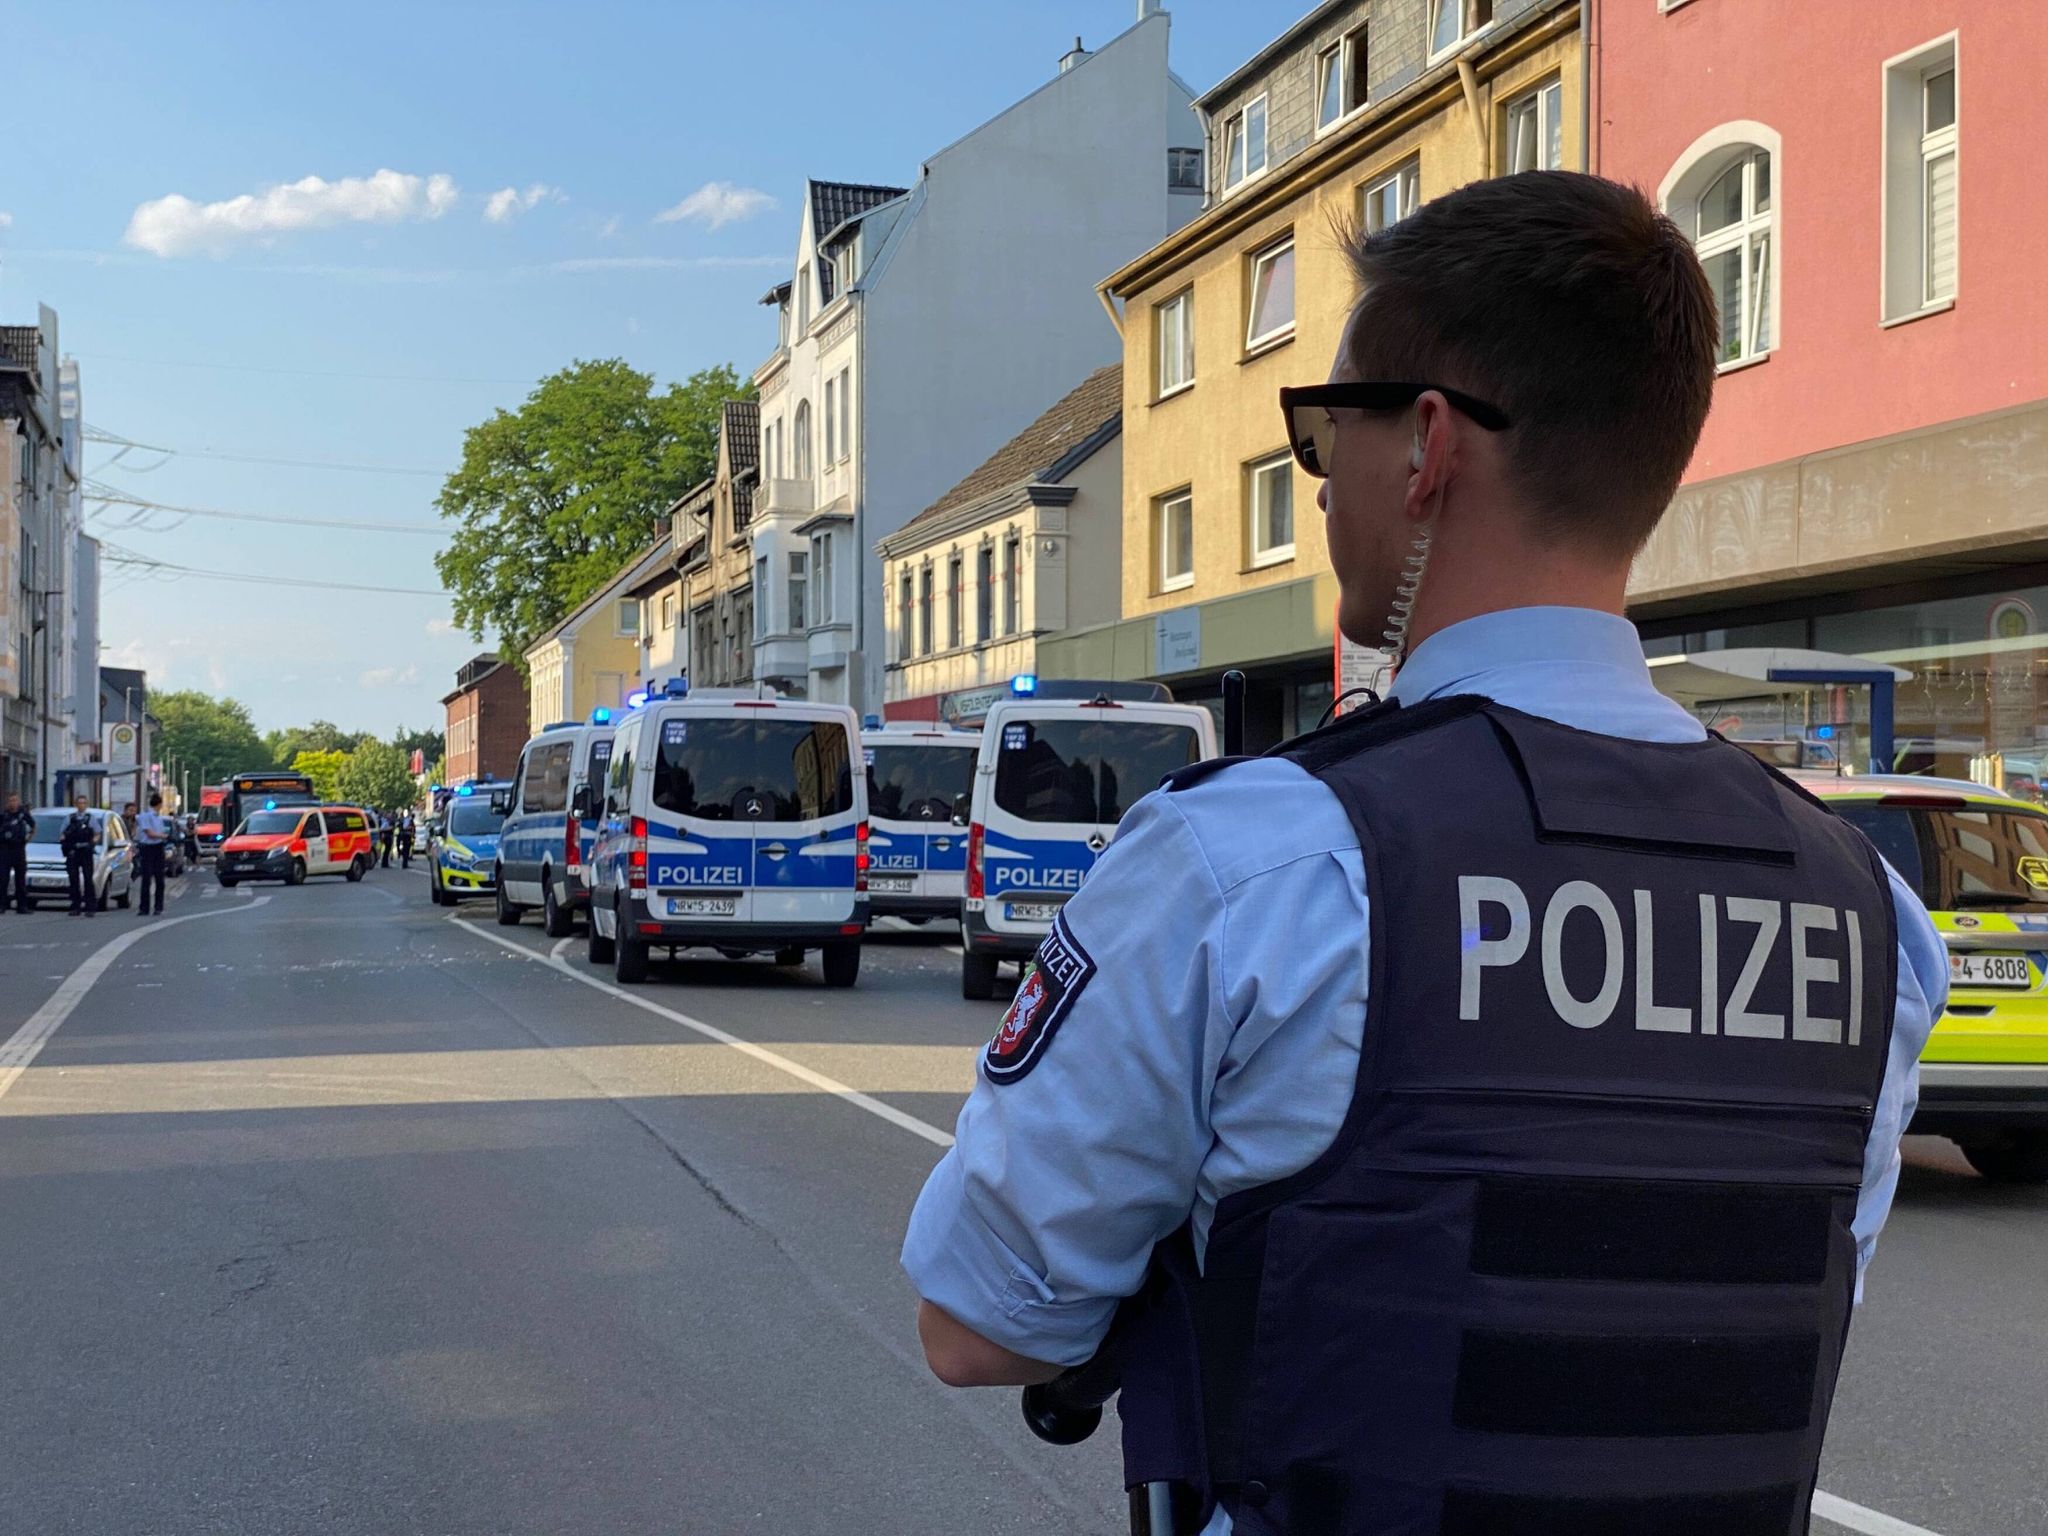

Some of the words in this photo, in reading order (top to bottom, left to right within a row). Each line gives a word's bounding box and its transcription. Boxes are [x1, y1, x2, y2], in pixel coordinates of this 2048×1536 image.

[868, 855, 918, 868] OLIZEI
[658, 866, 742, 884] POLIZEI
[996, 867, 1085, 887] POLIZEI
[1040, 930, 1079, 988] LIZEI
[1458, 875, 1863, 1046] POLIZEI
[1963, 957, 2027, 979] 4-6808
